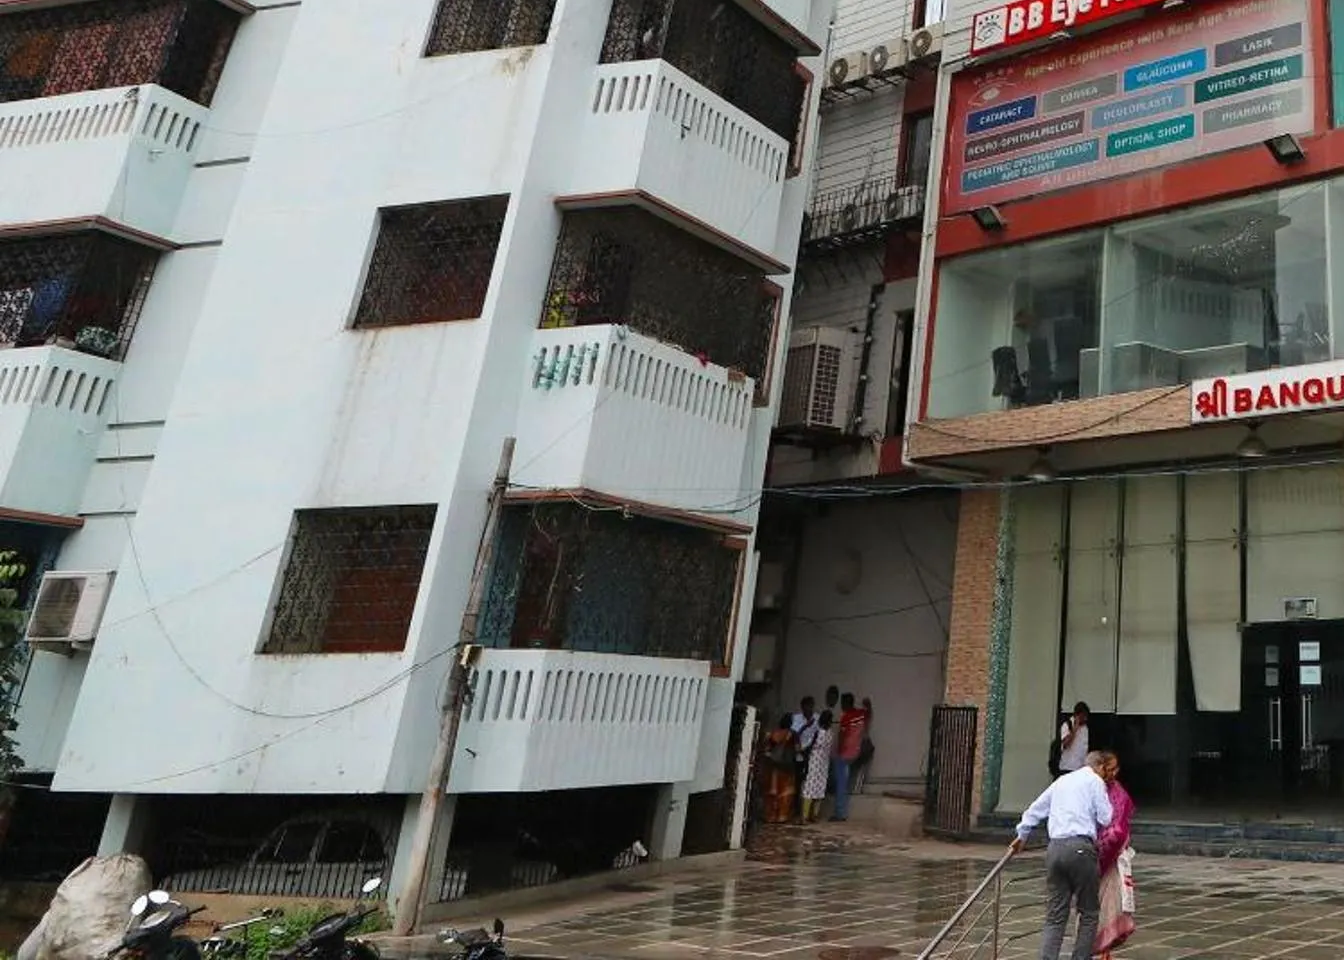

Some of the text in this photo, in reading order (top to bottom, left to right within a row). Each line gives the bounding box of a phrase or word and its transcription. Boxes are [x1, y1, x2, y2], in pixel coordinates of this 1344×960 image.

[1242, 37, 1274, 54] LASIK
[1135, 59, 1194, 83] GLAUCOMA
[1206, 64, 1290, 94] VITREO-RETINA
[979, 105, 1024, 126] CATARACT
[1221, 99, 1283, 123] PHARMACY
[1114, 123, 1187, 150] OPTICAL SHOP
